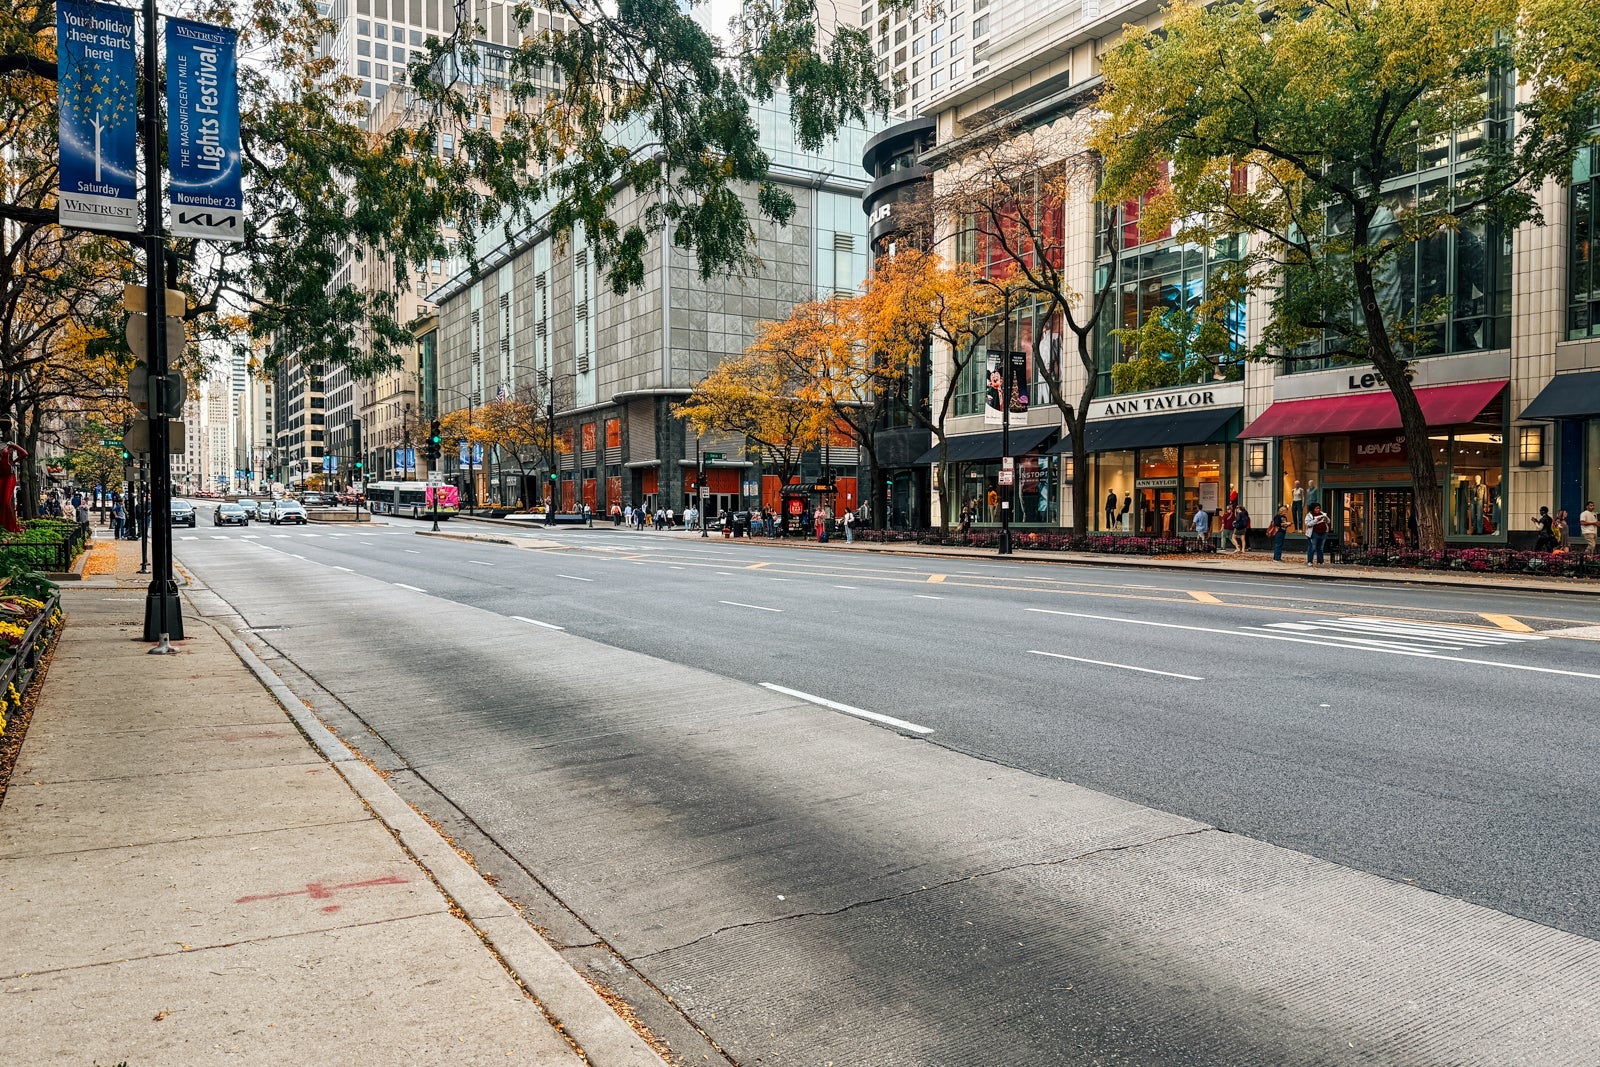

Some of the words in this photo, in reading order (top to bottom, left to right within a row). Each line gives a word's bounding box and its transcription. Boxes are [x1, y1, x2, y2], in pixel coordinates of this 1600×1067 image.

[63, 11, 90, 27] Your
[91, 16, 131, 38] holiday
[177, 25, 226, 44] WINTRUST
[66, 28, 98, 44] cheer
[100, 35, 130, 50] starts
[84, 45, 114, 62] here!
[178, 55, 187, 78] MILE
[192, 45, 219, 114] Festival
[179, 80, 189, 146] MAGNIFICENT
[195, 117, 226, 171] Lights
[181, 148, 190, 168] THE
[77, 180, 120, 198] Saturday
[177, 192, 223, 206] November
[224, 197, 236, 207] 23
[64, 198, 133, 217] WINTRUST
[178, 211, 236, 229] KIA
[1104, 400, 1138, 415] ANN
[1143, 391, 1214, 411] TAYLOR
